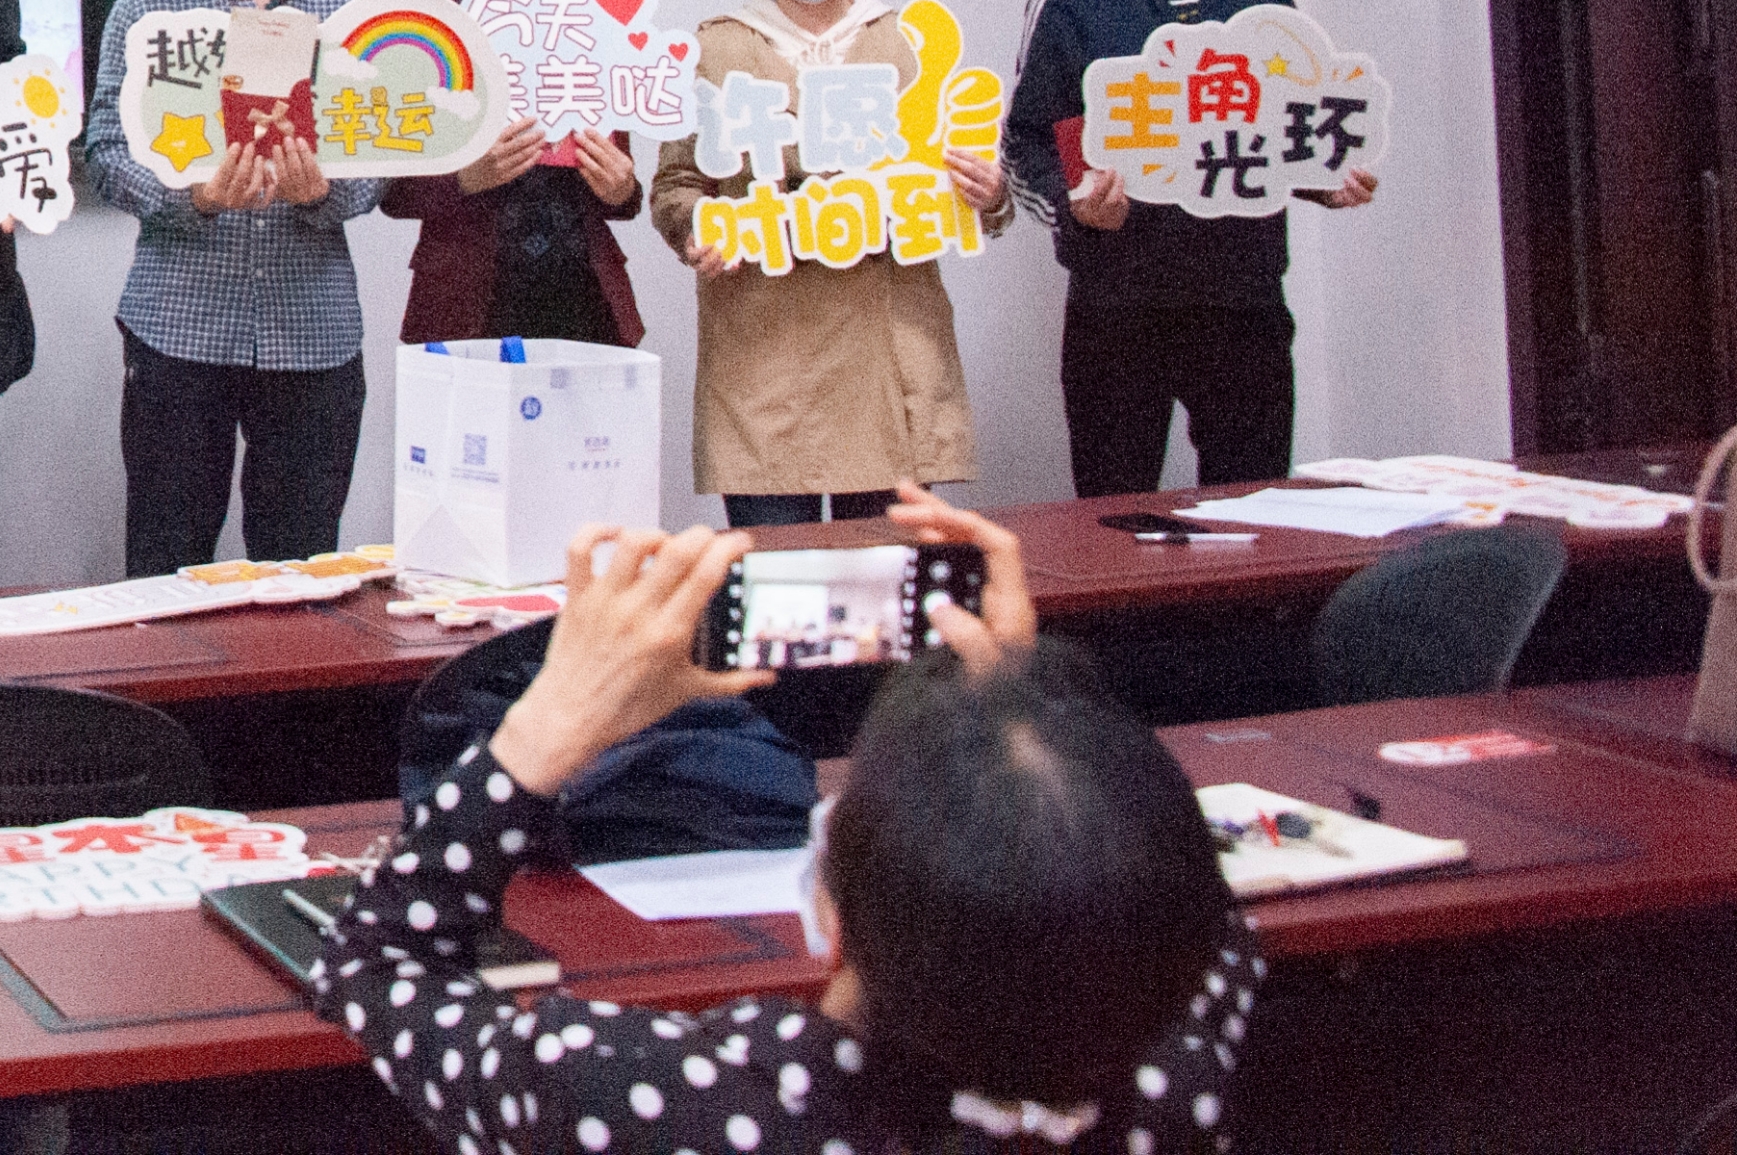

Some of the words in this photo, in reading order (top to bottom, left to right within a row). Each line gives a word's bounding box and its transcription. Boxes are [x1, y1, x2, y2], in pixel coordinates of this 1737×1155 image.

[322, 86, 436, 155] 幸运
[694, 66, 911, 180] 许愿
[1103, 47, 1262, 152] 主角
[1194, 96, 1368, 199] 光环
[697, 171, 981, 271] 时间到
